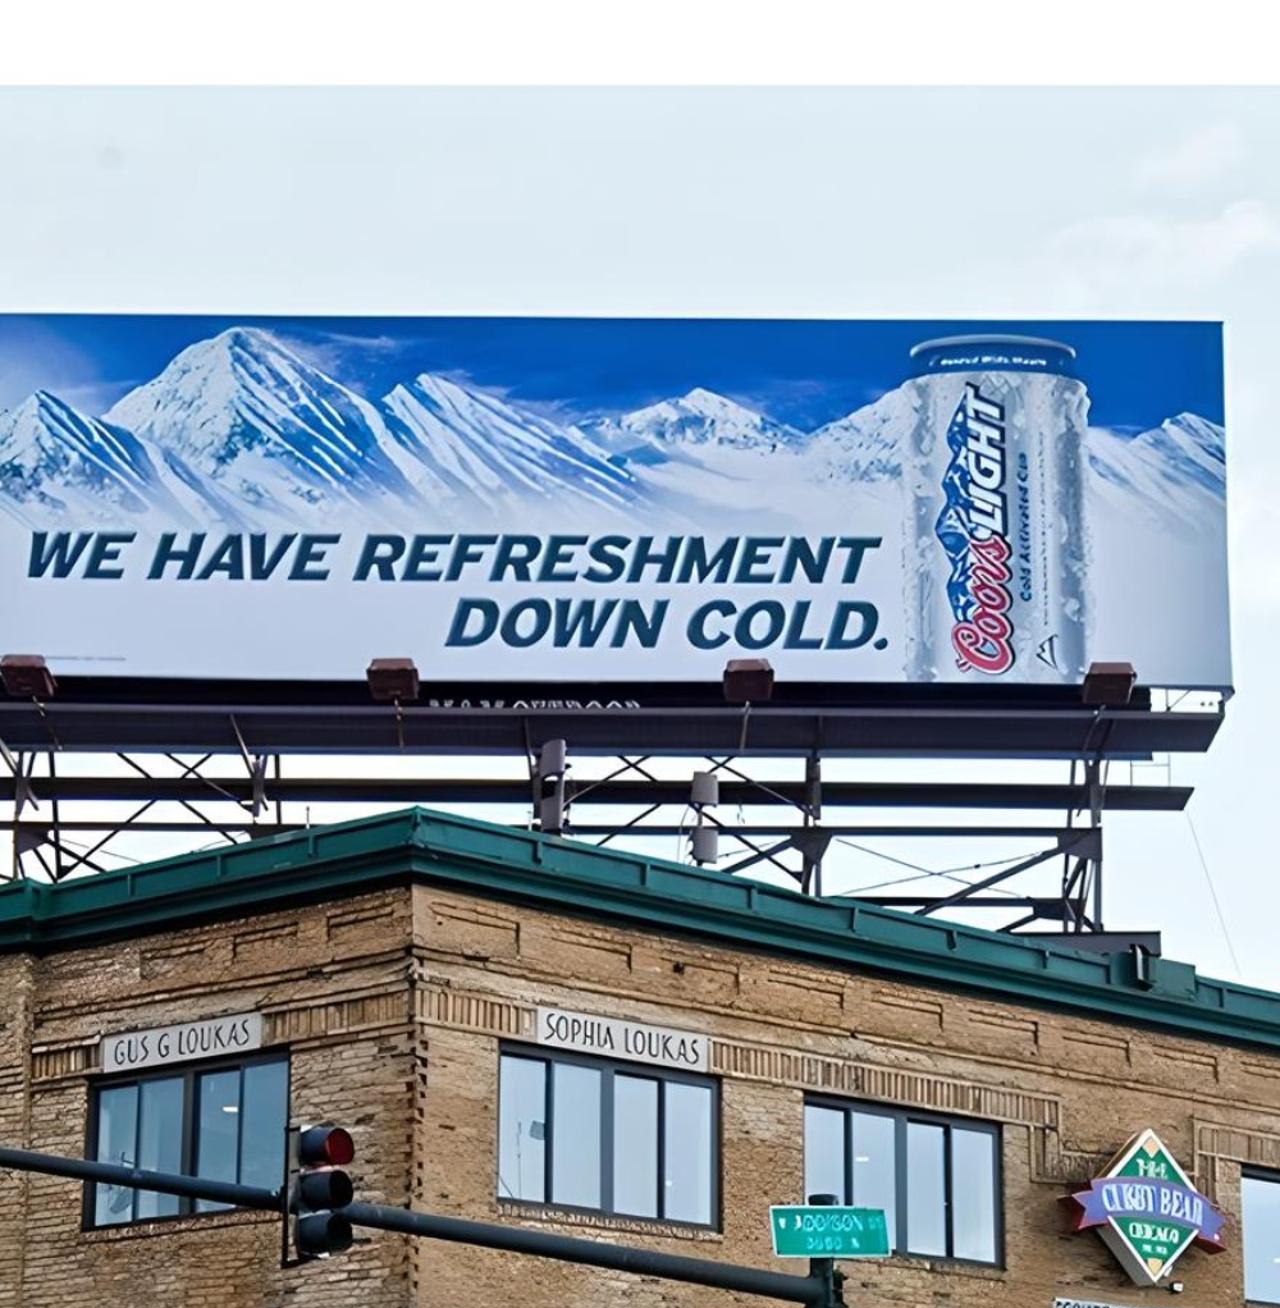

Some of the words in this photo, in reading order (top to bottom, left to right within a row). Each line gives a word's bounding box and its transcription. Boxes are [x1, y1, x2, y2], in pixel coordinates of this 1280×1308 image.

[964, 381, 1008, 539] LIGHT
[27, 531, 137, 579] WE
[146, 532, 341, 581] HAVE
[352, 533, 882, 584] REFRESHMENT
[445, 598, 670, 648] DOWN
[686, 600, 889, 651] COLD.
[951, 536, 1015, 674] Coors
[114, 1034, 149, 1065] GUS
[158, 1033, 170, 1058] G
[178, 1019, 250, 1055] LOUKAS
[544, 1013, 615, 1050] SOPHIA
[624, 1028, 700, 1065] LOUKAS
[1160, 1187, 1204, 1226] BEAR
